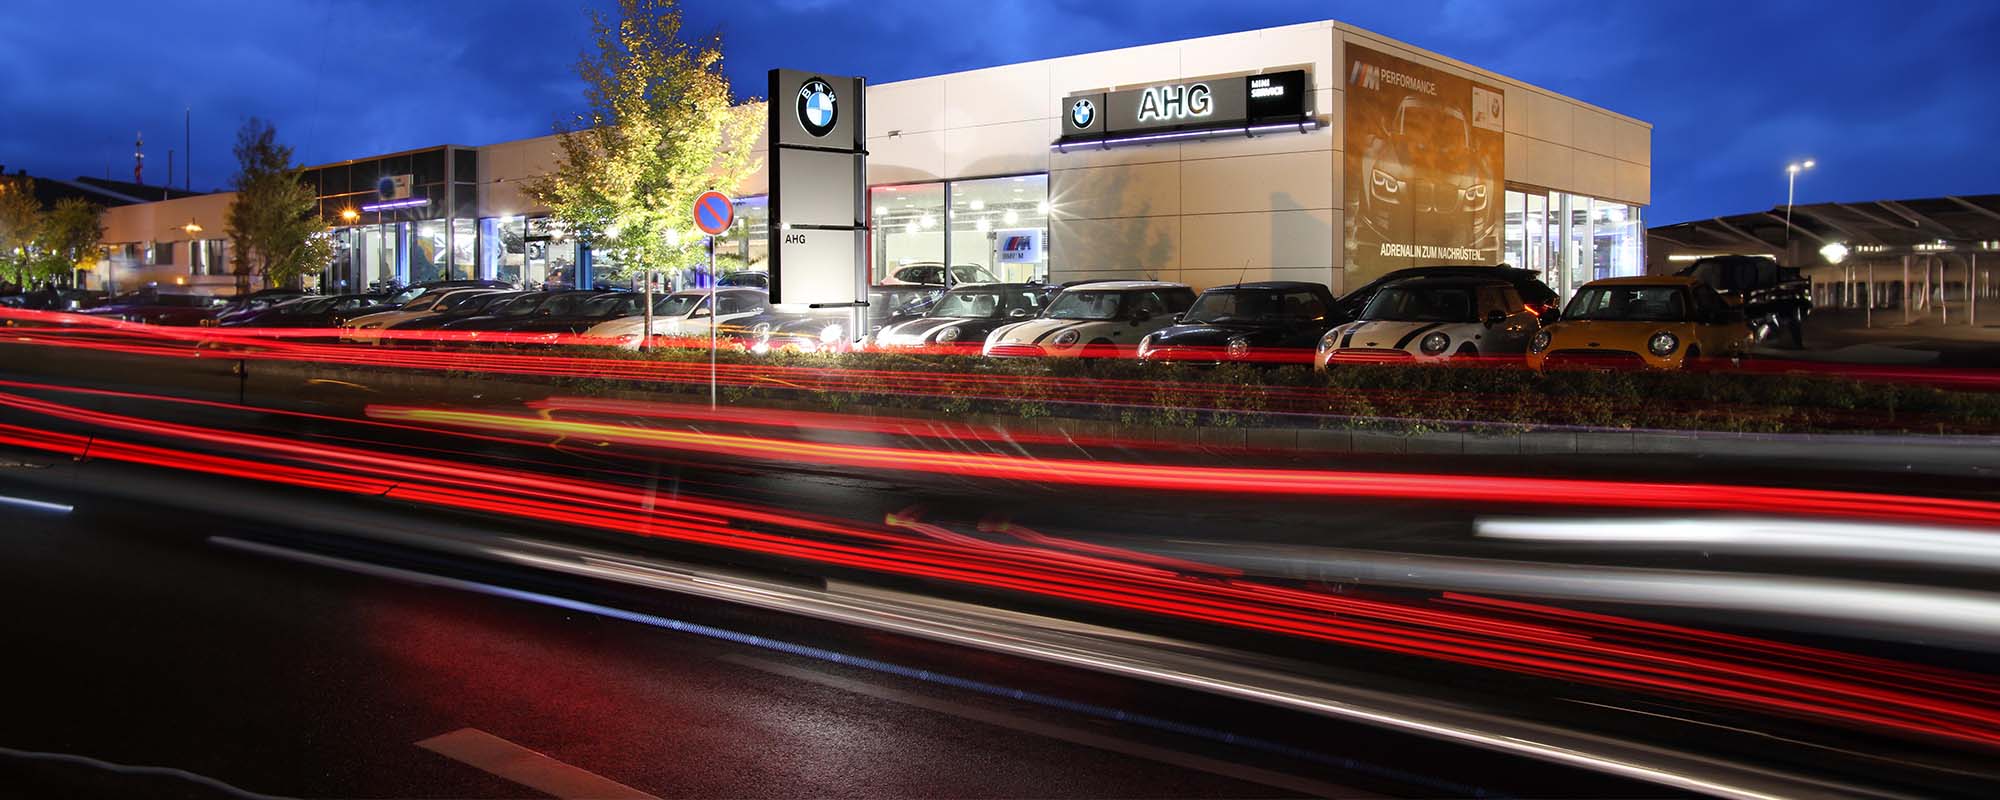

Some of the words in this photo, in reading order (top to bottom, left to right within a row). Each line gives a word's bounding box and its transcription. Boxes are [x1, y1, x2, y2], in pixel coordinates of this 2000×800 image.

[1251, 79, 1270, 88] MINI
[801, 83, 836, 102] BMW
[1251, 86, 1284, 97] SERVICE
[1138, 83, 1212, 121] AHG
[785, 234, 806, 244] AHG
[1380, 243, 1421, 258] ADRENALIN
[1422, 246, 1437, 258] ZUM
